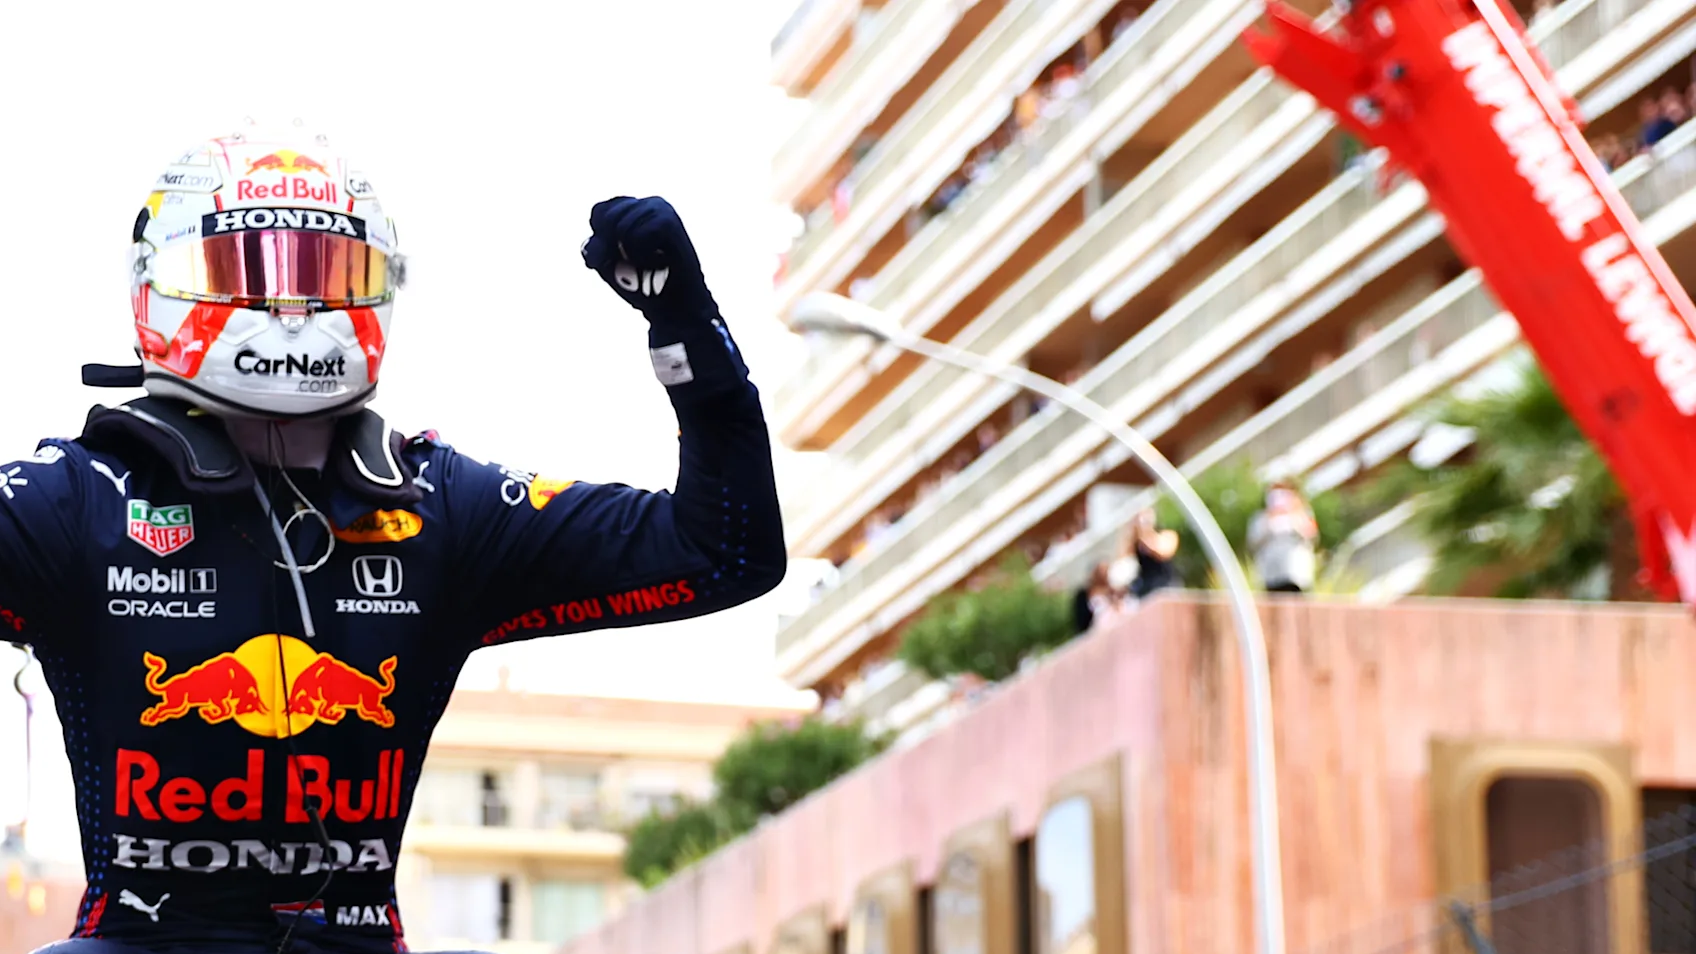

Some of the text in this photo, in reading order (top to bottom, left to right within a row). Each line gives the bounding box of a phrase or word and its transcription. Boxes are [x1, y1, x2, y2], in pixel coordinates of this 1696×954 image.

[237, 177, 338, 204] Red Bull
[215, 208, 357, 236] HONDA
[234, 351, 346, 377] CarNext
[295, 379, 338, 393] .com
[131, 503, 188, 525] TAG
[131, 523, 191, 554] HEUER
[107, 566, 185, 593] Mobil
[107, 599, 216, 618] ORACLE
[336, 599, 421, 614] HONDA
[482, 580, 695, 645] GIVES YOU WINGS
[114, 747, 403, 823] Red Bull
[112, 833, 393, 875] HONDA
[336, 904, 390, 926] MAX
